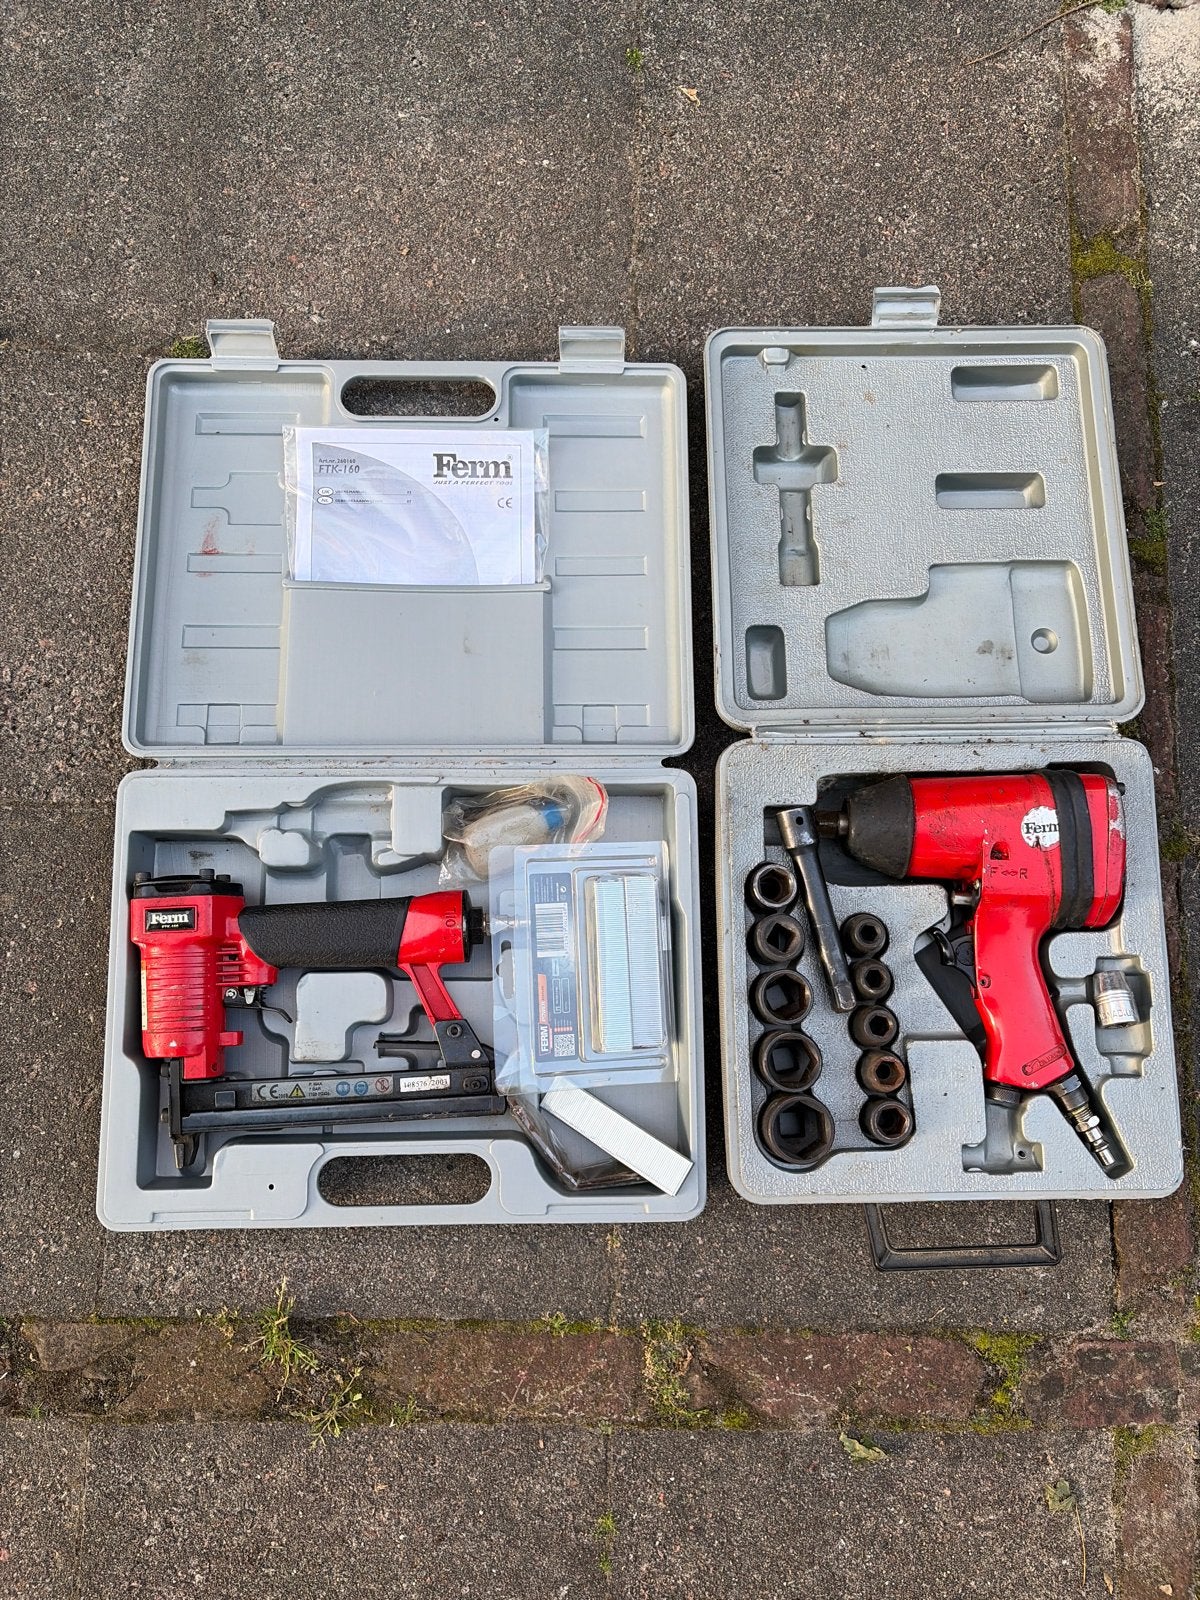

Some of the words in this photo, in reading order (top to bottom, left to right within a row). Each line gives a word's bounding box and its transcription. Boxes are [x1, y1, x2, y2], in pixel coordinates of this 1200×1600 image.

[318, 464, 360, 474] FTK-160
[433, 453, 513, 478] Ferm
[1019, 868, 1028, 879] R
[150, 912, 189, 924] Ferm
[540, 1026, 550, 1052] FERM
